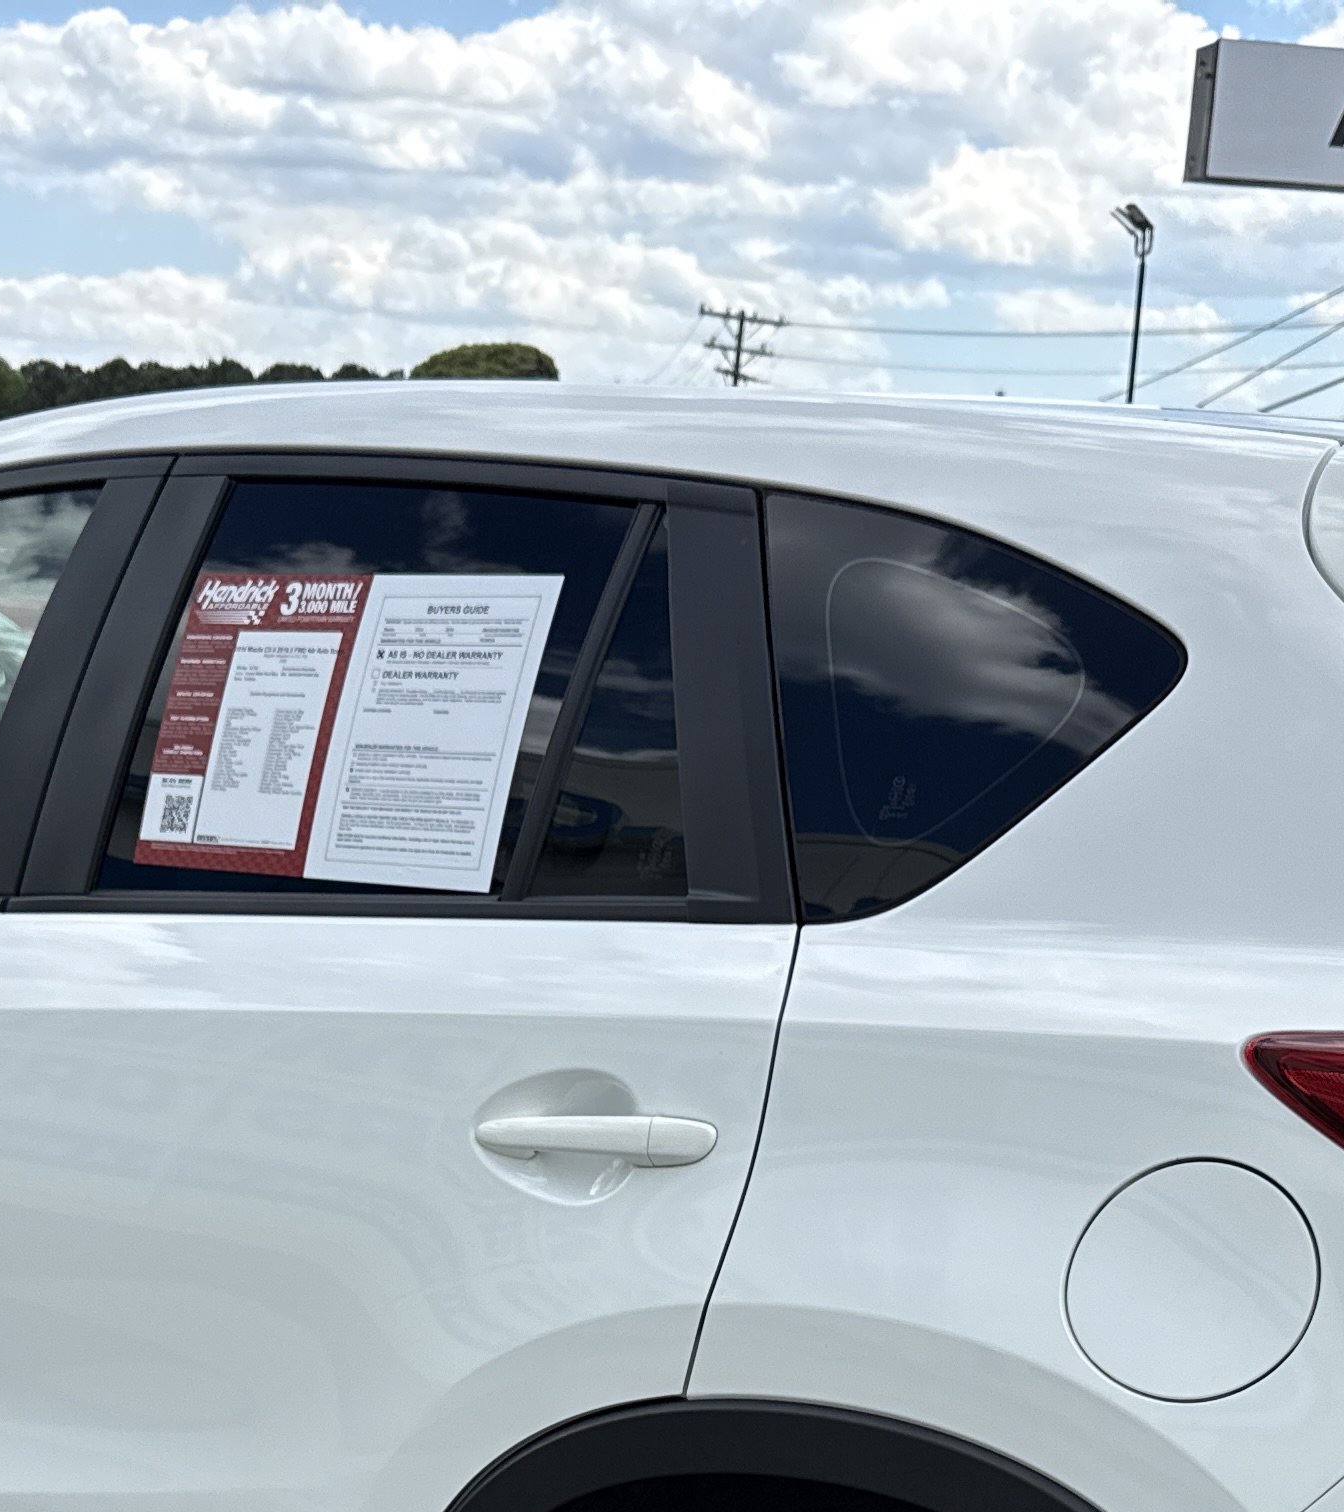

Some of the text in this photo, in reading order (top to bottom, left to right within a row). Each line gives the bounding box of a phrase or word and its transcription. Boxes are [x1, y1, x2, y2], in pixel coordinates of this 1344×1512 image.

[197, 579, 280, 610] Hendrick
[280, 582, 302, 615] 3
[329, 600, 358, 614] MILE
[427, 605, 490, 615] BUYERS GUIDE
[388, 650, 398, 659] AS
[413, 650, 425, 659] NO
[426, 650, 457, 660] DEALER
[458, 650, 503, 660] WARRANTY
[382, 671, 459, 681] DEALER WARRANTY
